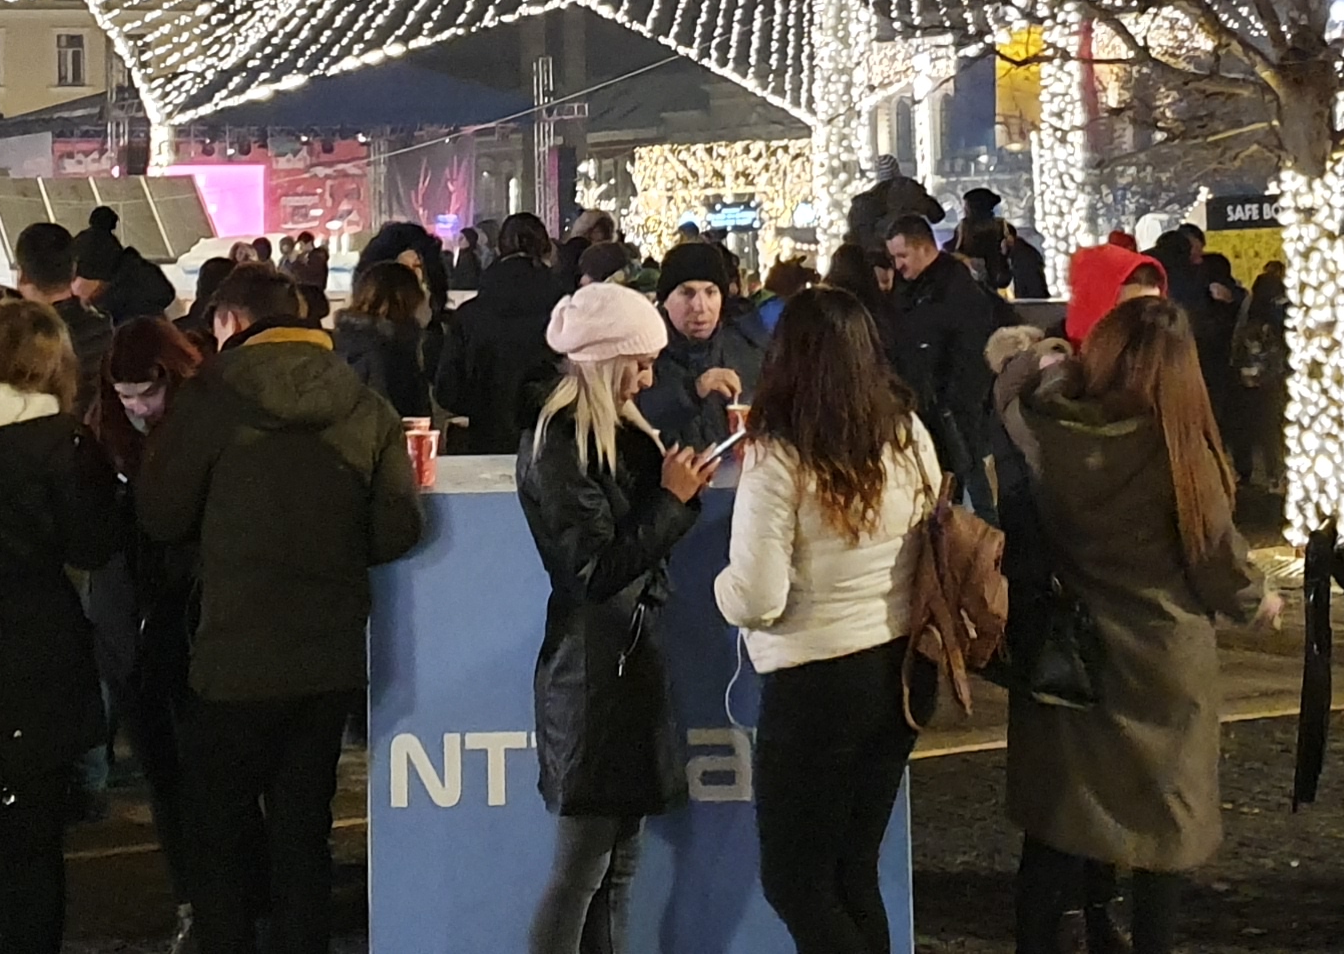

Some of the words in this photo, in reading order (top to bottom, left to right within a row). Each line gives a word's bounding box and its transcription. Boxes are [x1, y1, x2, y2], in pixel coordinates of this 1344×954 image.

[1226, 204, 1259, 222] SAFE
[1262, 202, 1283, 220] BO
[389, 730, 538, 808] NT
